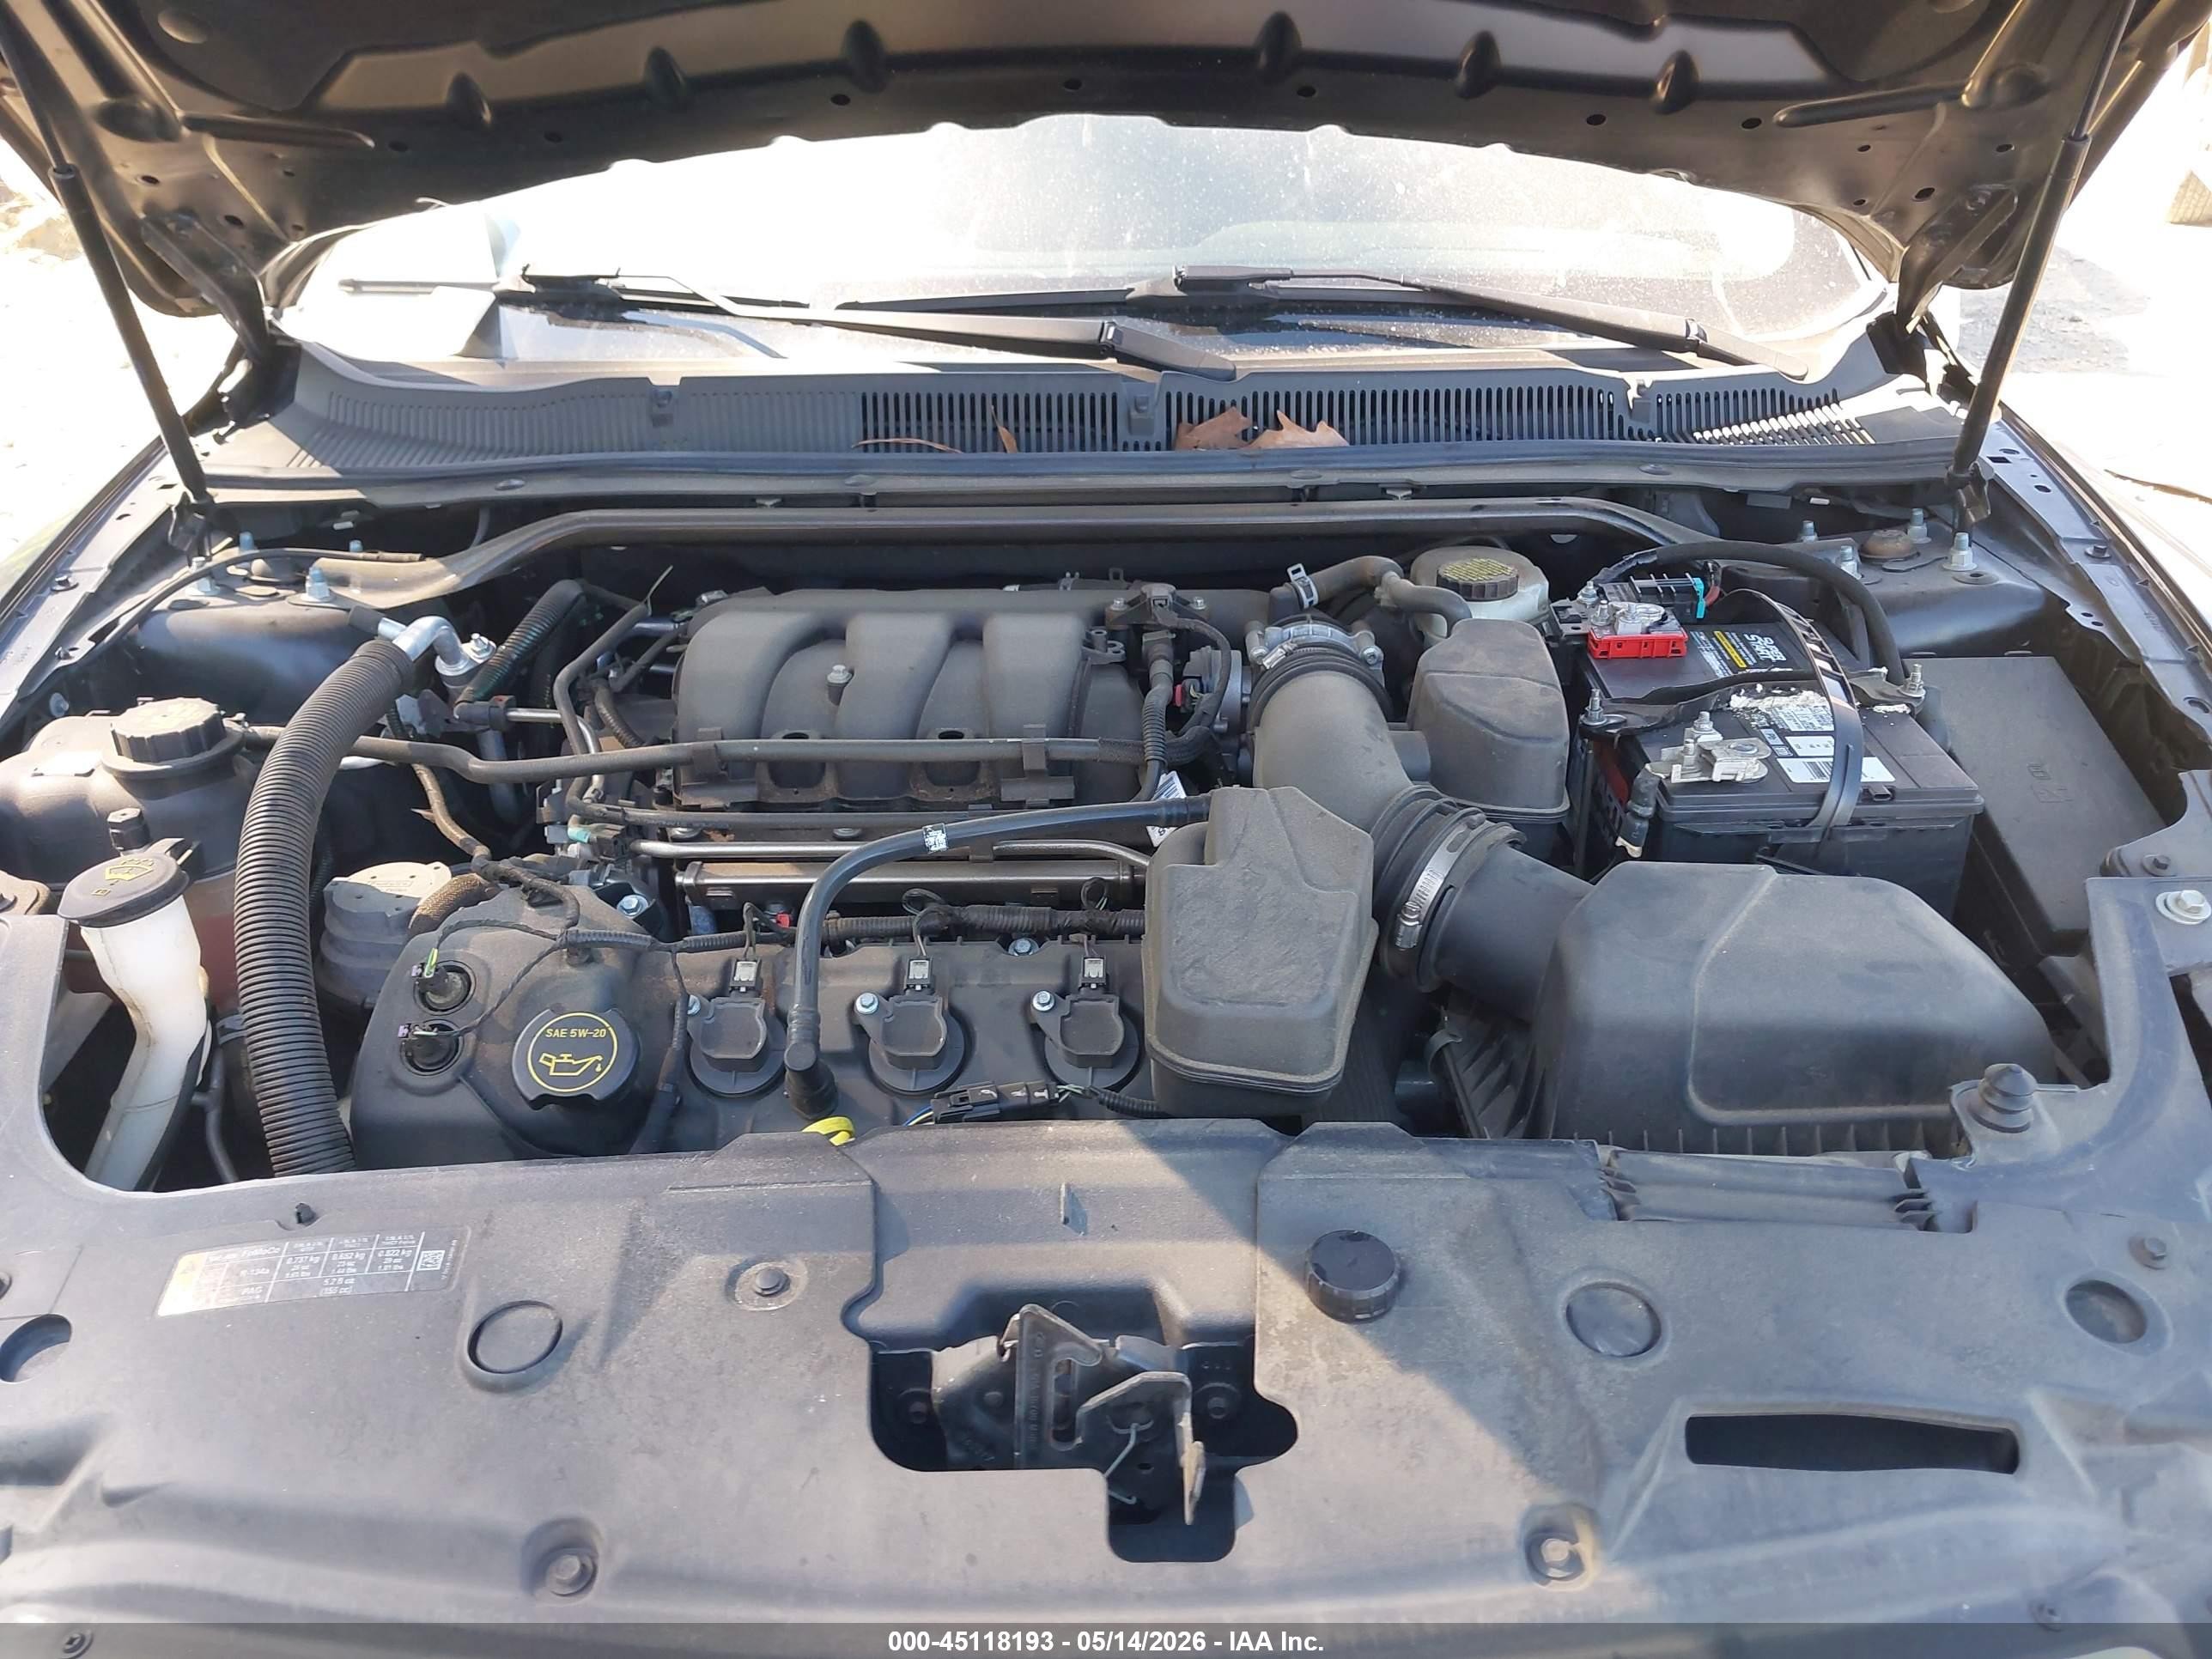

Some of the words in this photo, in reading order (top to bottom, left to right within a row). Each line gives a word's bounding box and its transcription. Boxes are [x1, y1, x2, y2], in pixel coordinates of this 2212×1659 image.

[1743, 634, 1776, 662] START
[545, 1028, 568, 1038] SAE
[569, 1028, 607, 1038] 5W-20
